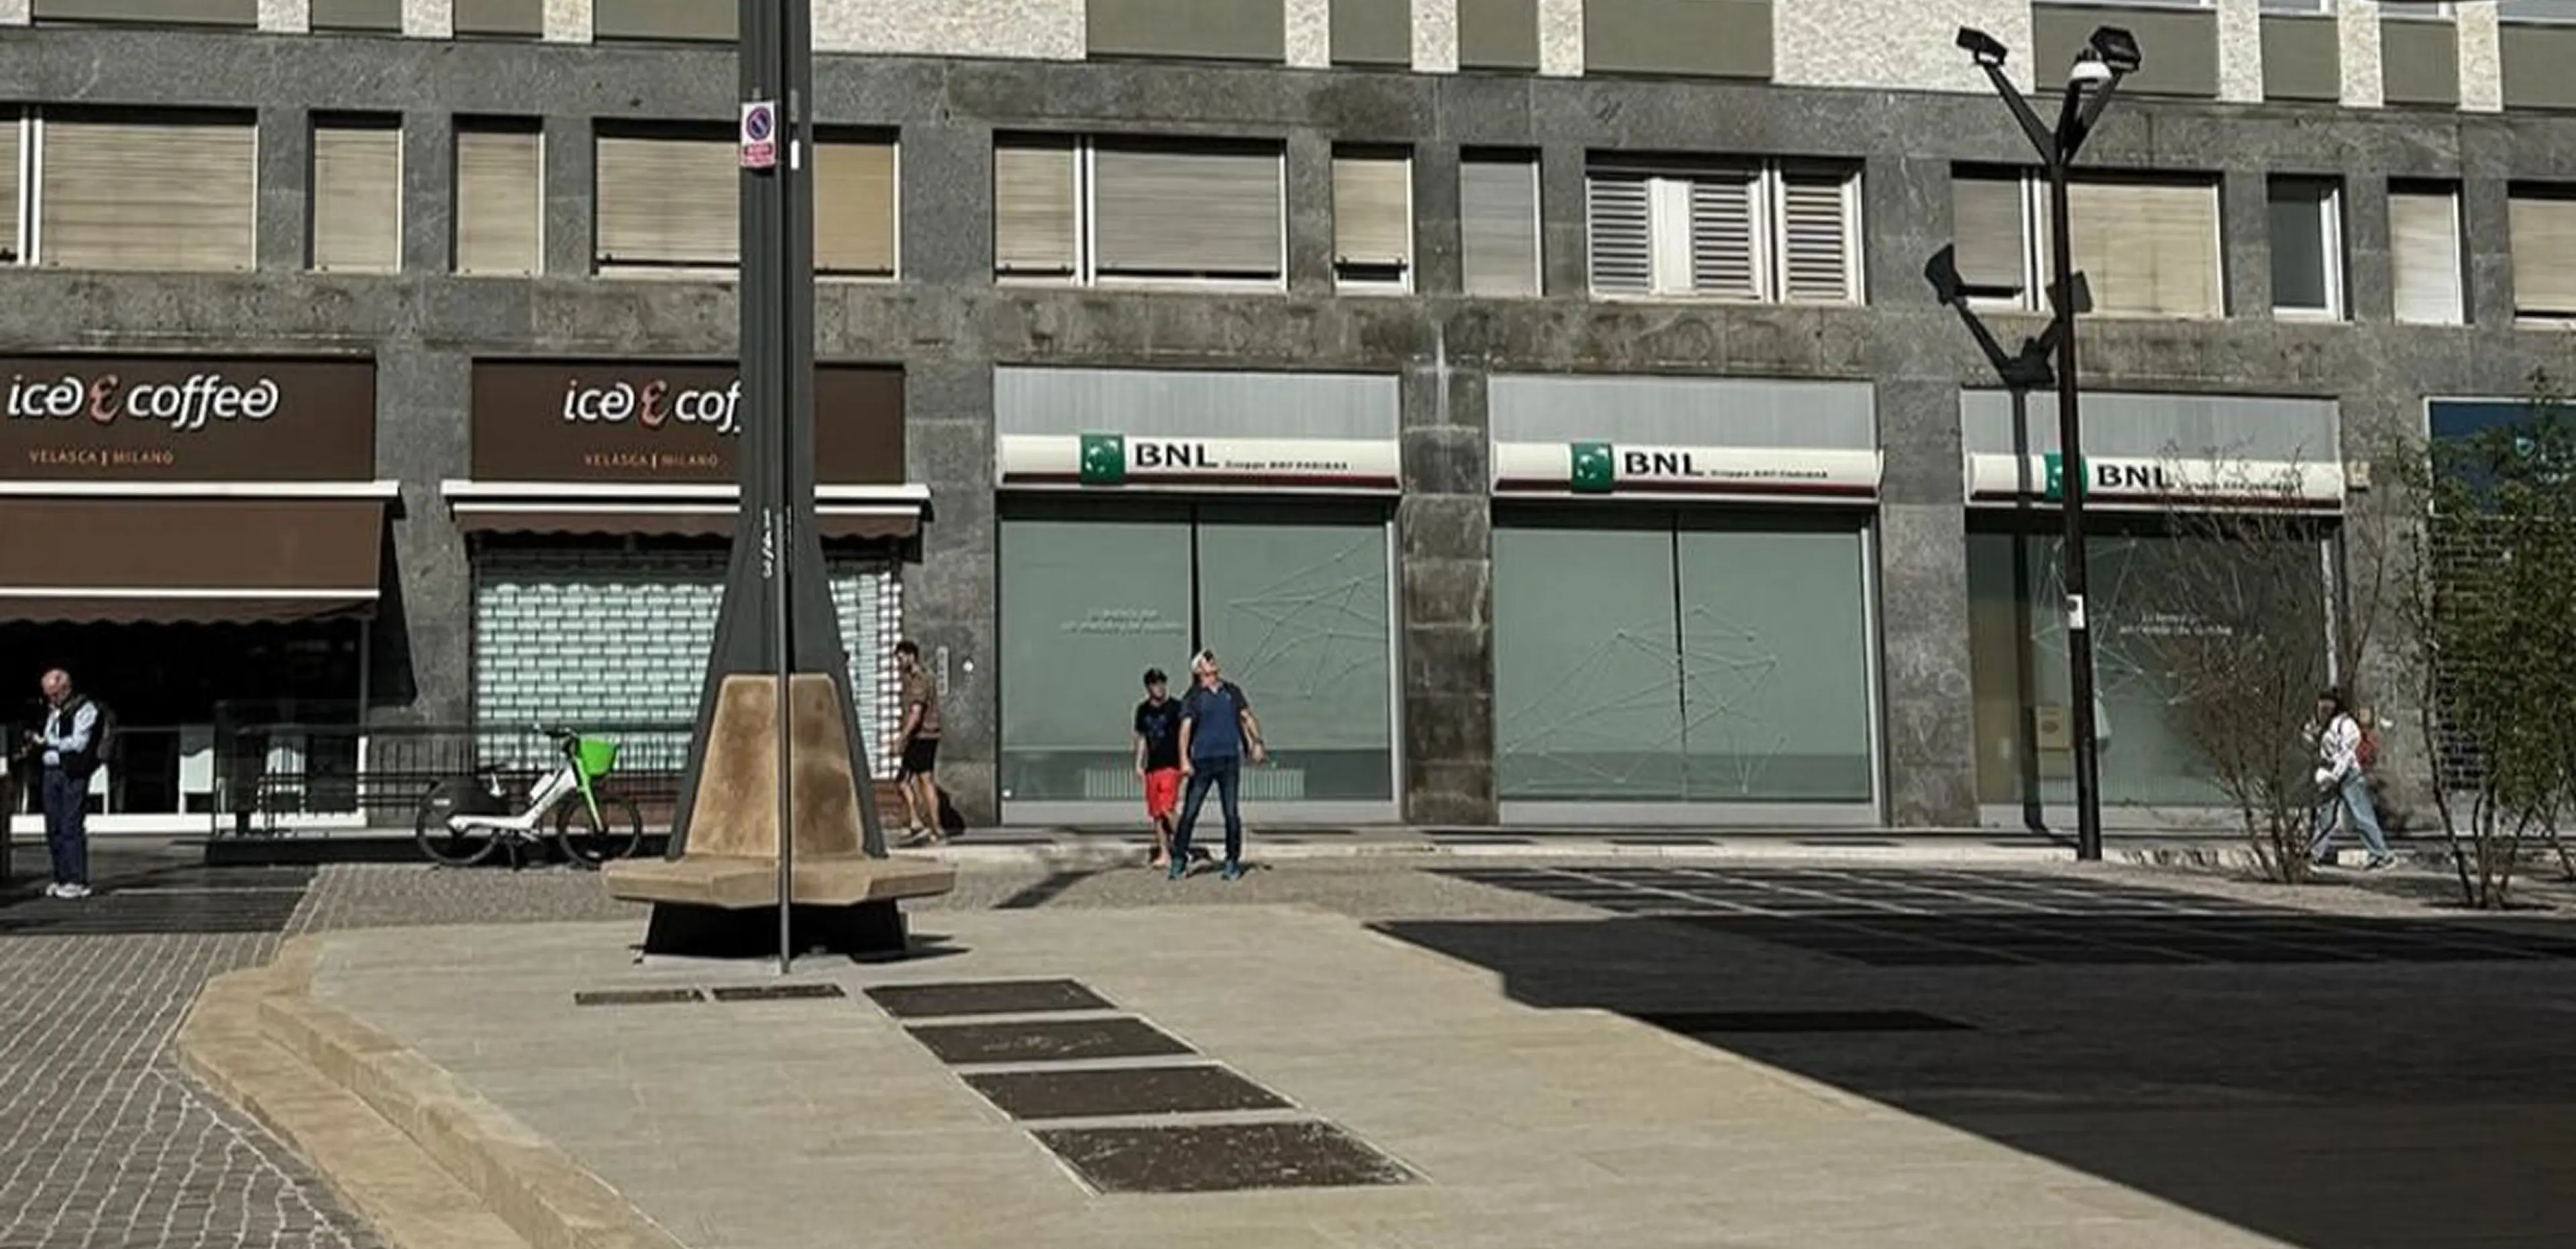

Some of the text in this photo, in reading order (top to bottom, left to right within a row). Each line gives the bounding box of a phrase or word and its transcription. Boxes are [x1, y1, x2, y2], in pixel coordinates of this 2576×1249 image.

[7, 374, 84, 417] ice
[127, 374, 279, 429] coffee
[564, 378, 635, 421] ice
[675, 380, 741, 433] cof
[29, 449, 96, 464] VELASCA
[112, 449, 174, 465] MILANO
[584, 453, 648, 467] VELASCA
[661, 452, 718, 468] MILANO
[1135, 443, 1219, 468] BNL
[1624, 452, 1704, 476] BNL
[2097, 464, 2175, 488] BNL
